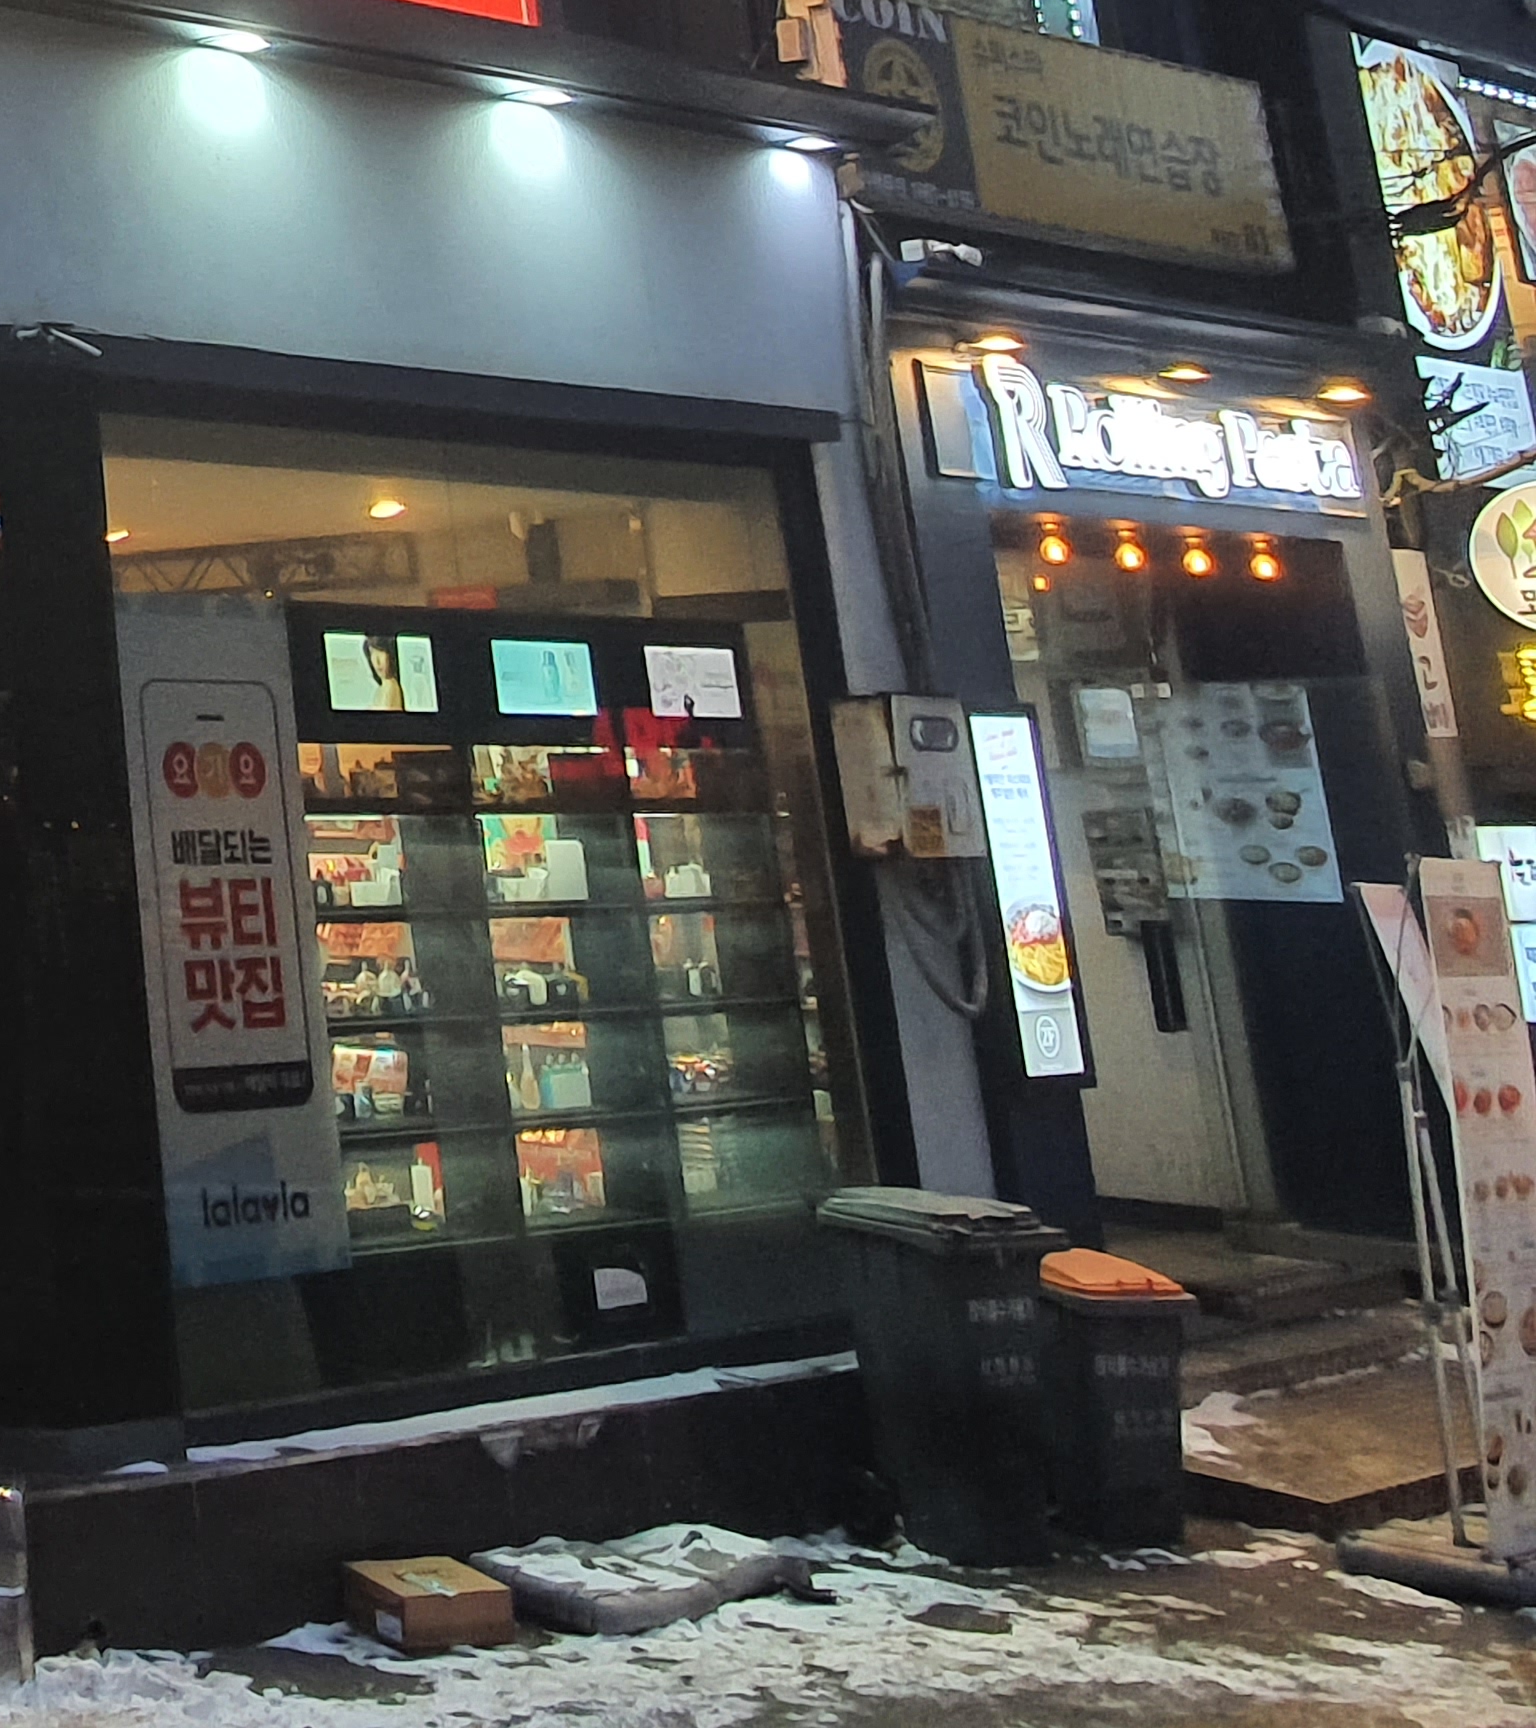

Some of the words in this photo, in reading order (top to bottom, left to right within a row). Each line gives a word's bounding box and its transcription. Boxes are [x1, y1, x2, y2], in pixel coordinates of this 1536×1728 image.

[995, 94, 1222, 197] 코인노래연습장
[1044, 380, 1231, 499] Rolling
[1216, 408, 1361, 499] Pasta
[171, 829, 273, 866] 배달되는
[179, 877, 278, 951] 뷰티
[184, 955, 286, 1034] 맛집
